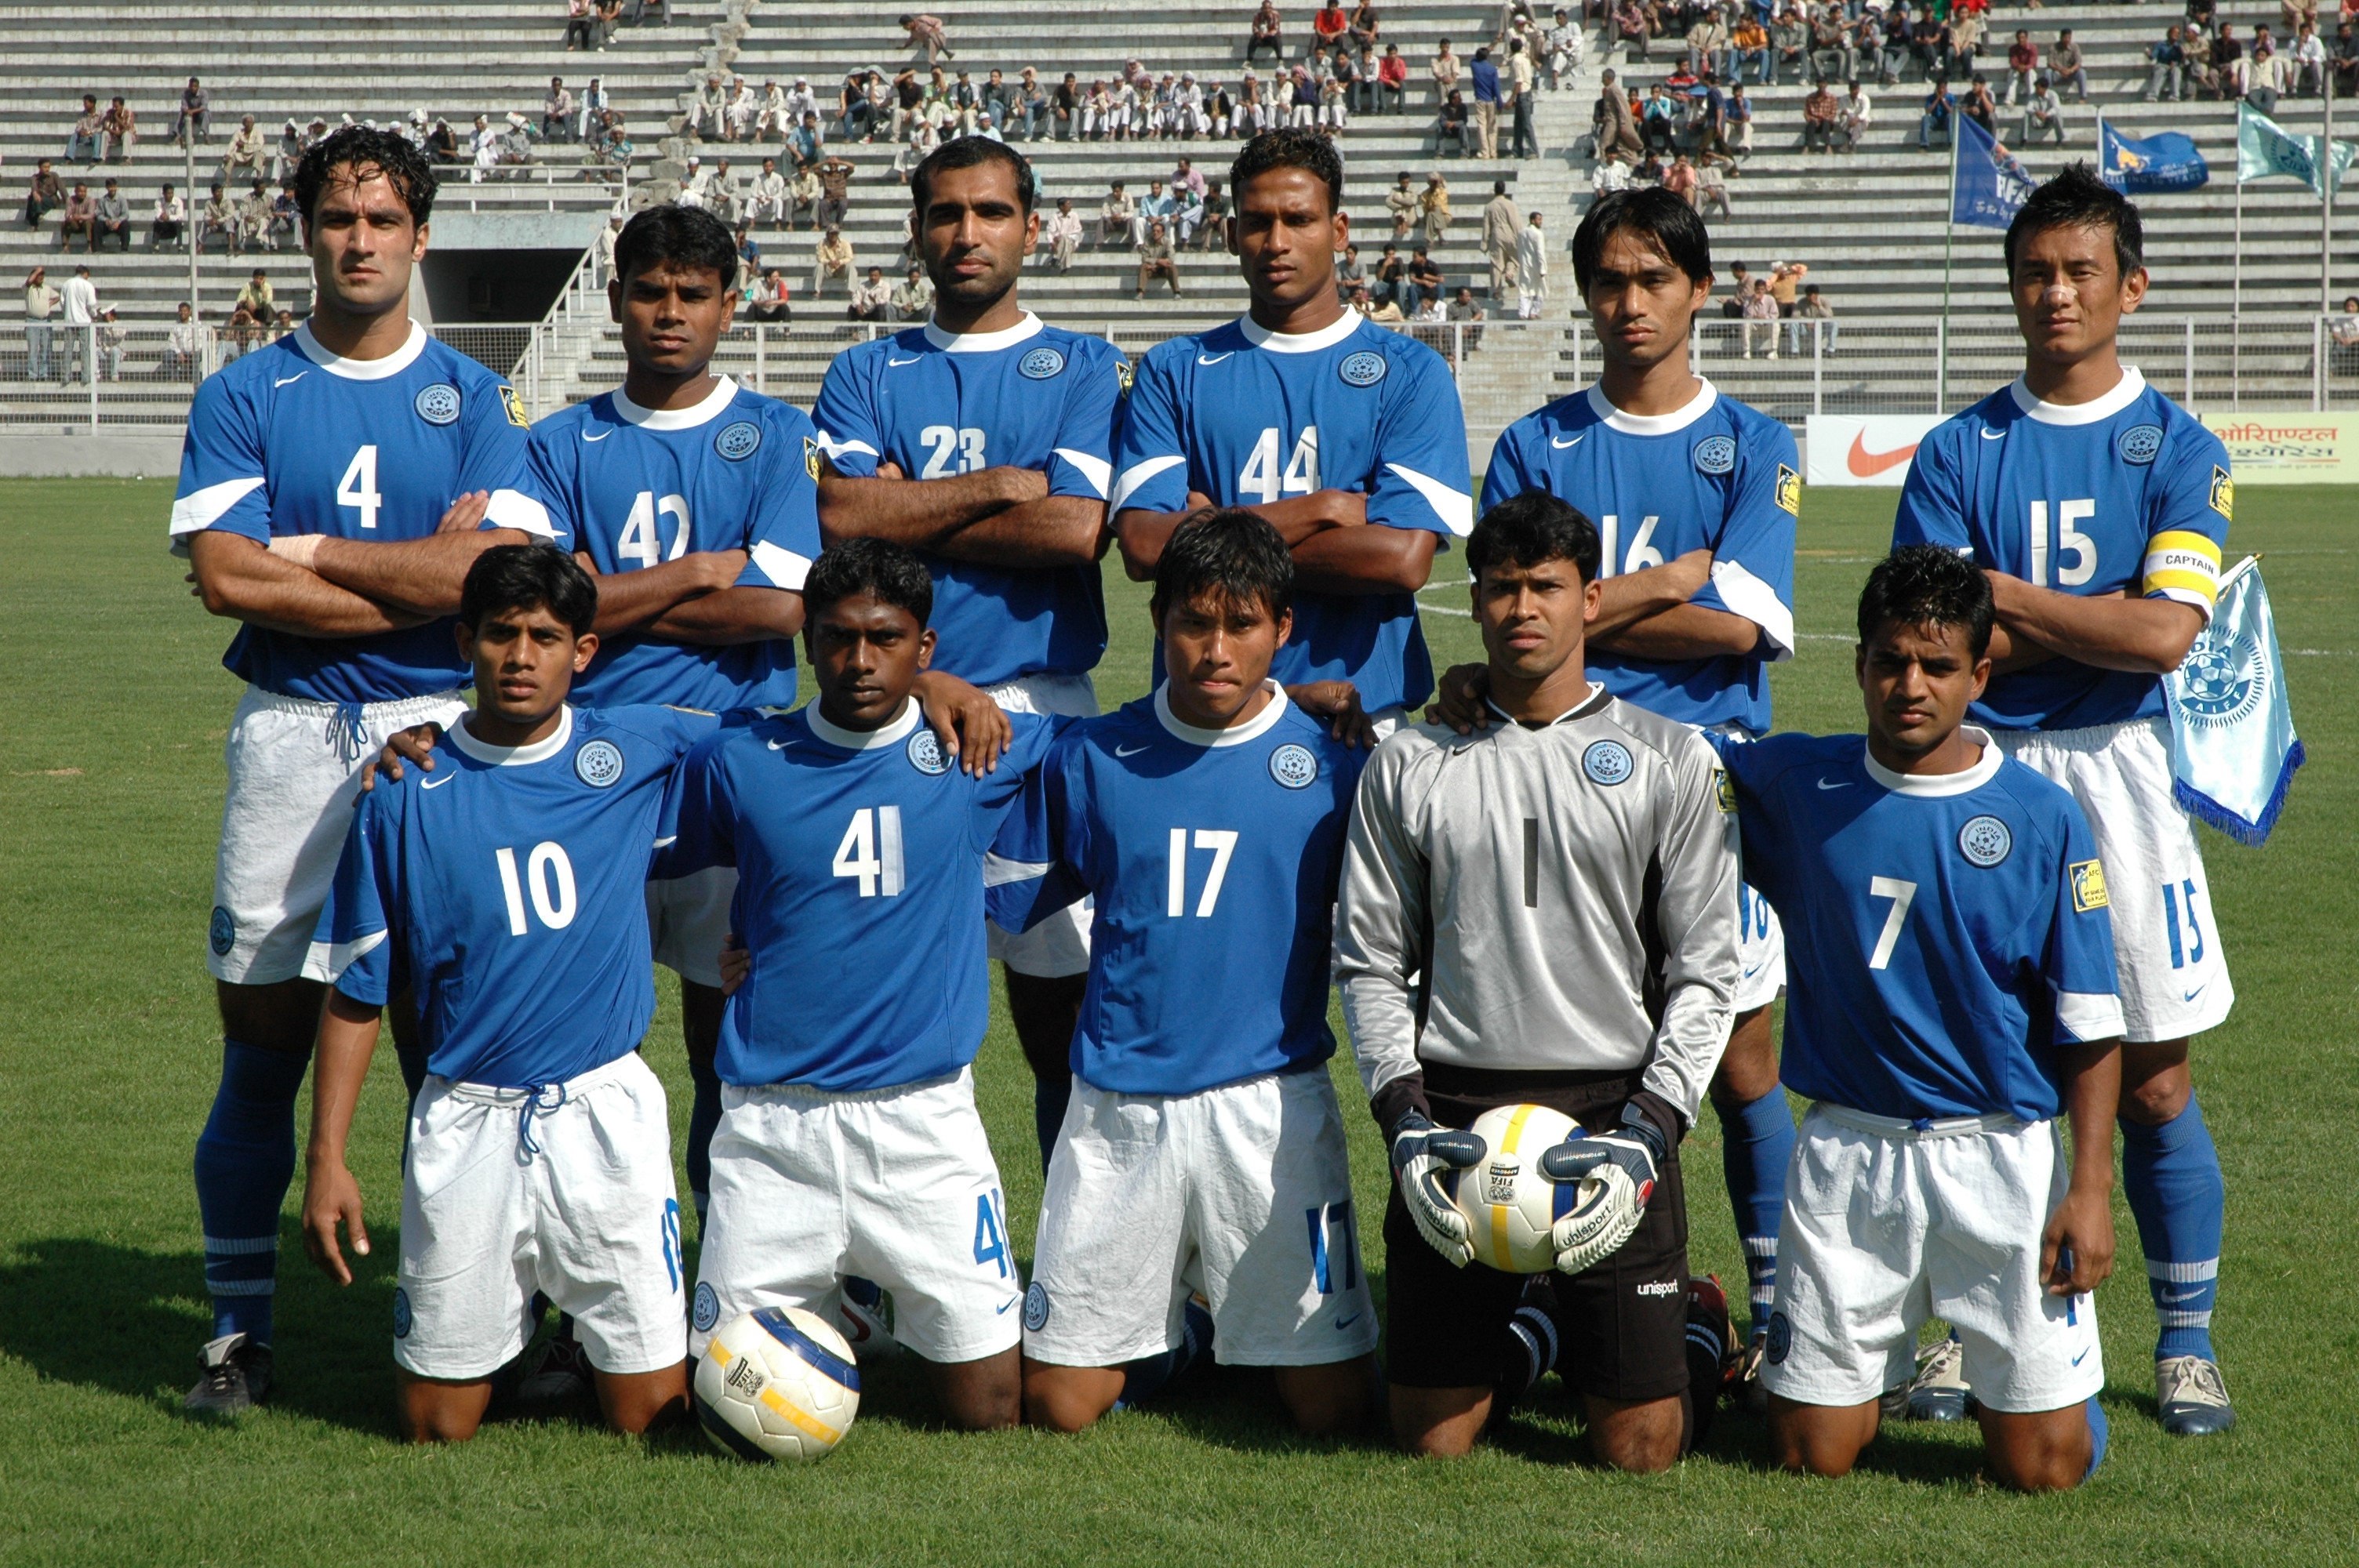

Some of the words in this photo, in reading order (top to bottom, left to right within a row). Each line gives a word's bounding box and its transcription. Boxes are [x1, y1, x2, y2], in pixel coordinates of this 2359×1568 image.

[336, 445, 382, 528] 4
[921, 426, 985, 479] 23
[1239, 426, 1321, 503] 44
[617, 492, 690, 568] 42
[1602, 515, 1664, 579] 16
[2030, 499, 2098, 586] 15
[2166, 554, 2214, 575] CAPTAIN
[2195, 691, 2242, 714] AIFF
[1596, 749, 1621, 760] INDIA
[832, 805, 904, 897] 41
[1523, 818, 1539, 908] 1
[1976, 826, 2001, 841] INDIA
[496, 840, 577, 936] 10
[1168, 828, 1239, 917] 17
[1869, 876, 1917, 970] 7
[2162, 877, 2204, 969] 15
[1416, 1196, 1459, 1239] uhlsport
[1491, 1177, 1513, 1187] FIFA
[973, 1188, 1016, 1281] 41
[1306, 1200, 1356, 1294] 17
[1563, 1205, 1612, 1247] uhlsport
[1637, 1279, 1678, 1298] unisport
[736, 1367, 754, 1390] FIFA
